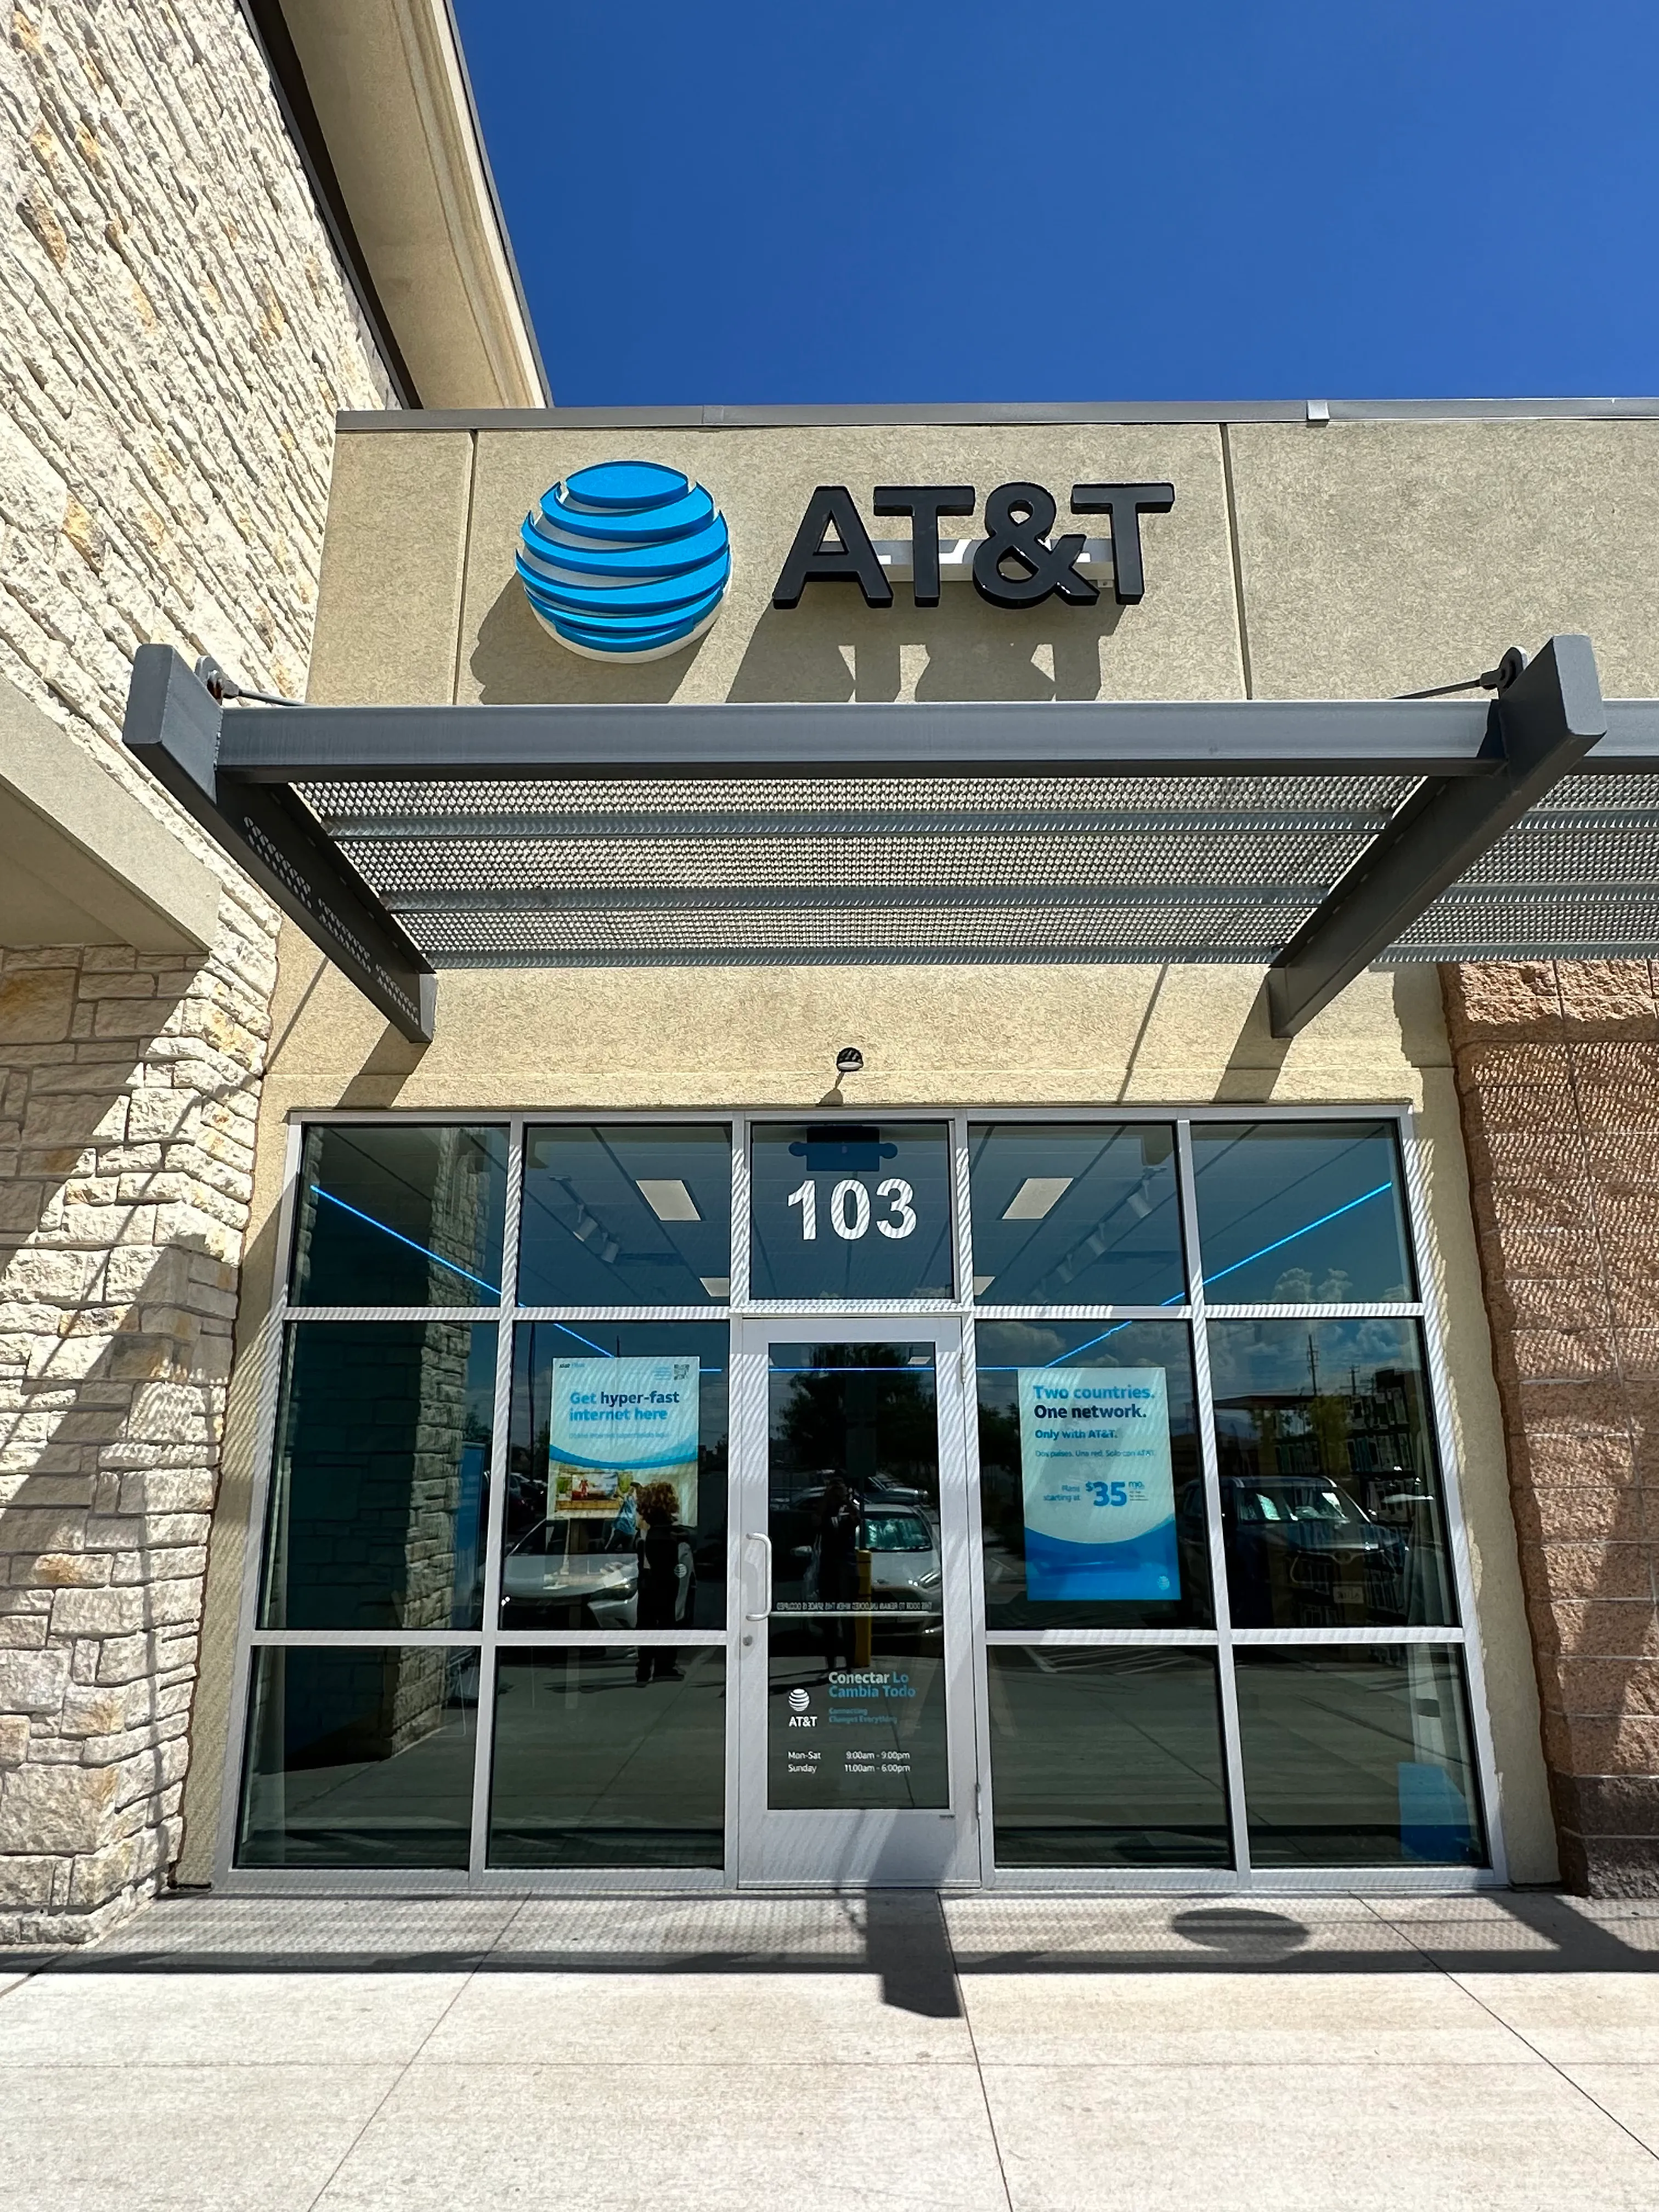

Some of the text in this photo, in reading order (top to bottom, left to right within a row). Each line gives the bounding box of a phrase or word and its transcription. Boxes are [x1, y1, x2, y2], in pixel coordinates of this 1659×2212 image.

[772, 482, 1175, 609] AT&T
[787, 1178, 917, 1240] 103
[570, 1390, 680, 1407] Get hyper-fast
[1033, 1384, 1155, 1399] Two countries.
[569, 1407, 668, 1421] internet here
[1034, 1403, 1147, 1419] One network.
[1035, 1429, 1118, 1441] Only with AT&T.
[1085, 1481, 1127, 1506] $35
[828, 1671, 909, 1684] Conectar Lo
[828, 1685, 916, 1697] Cambia Todo
[789, 1716, 817, 1727] AT&T
[788, 1751, 822, 1759] Mon-Sat
[788, 1764, 817, 1773] Sunday
